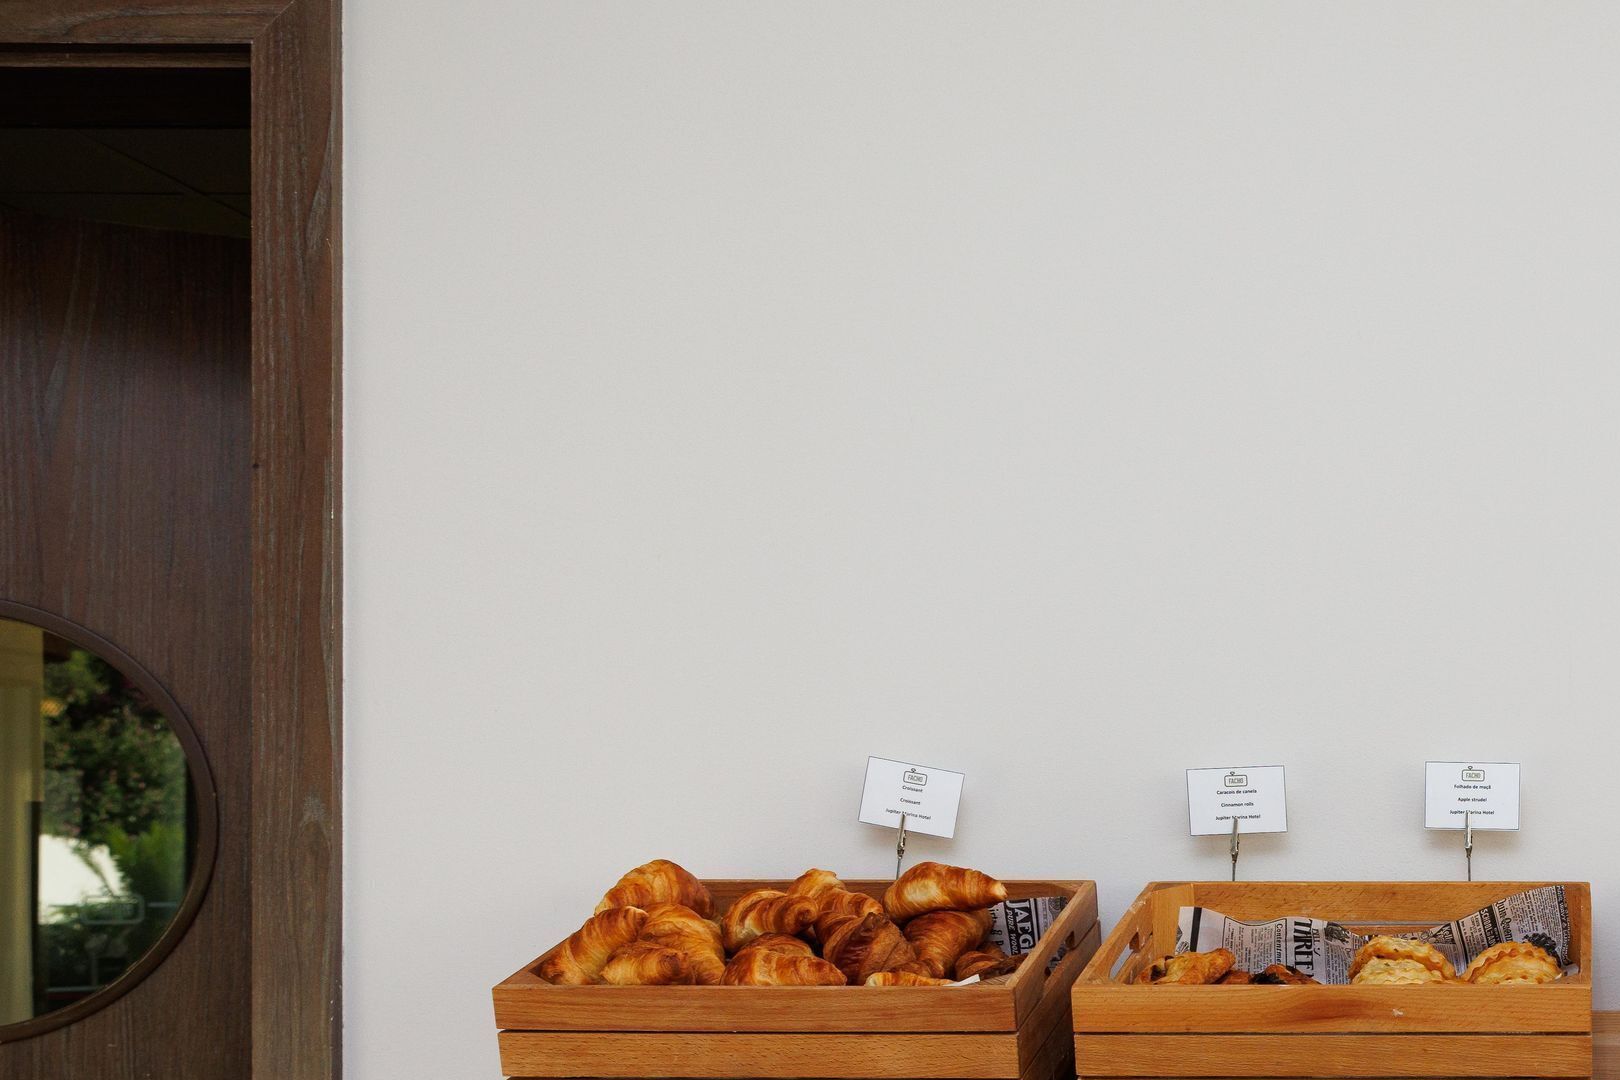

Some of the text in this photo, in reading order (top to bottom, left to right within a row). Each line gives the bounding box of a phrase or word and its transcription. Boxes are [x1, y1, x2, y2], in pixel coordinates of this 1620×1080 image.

[907, 774, 924, 783] FACHO
[902, 785, 923, 793] Croissant
[900, 797, 921, 806] Croissant
[885, 807, 901, 815] Jupiter
